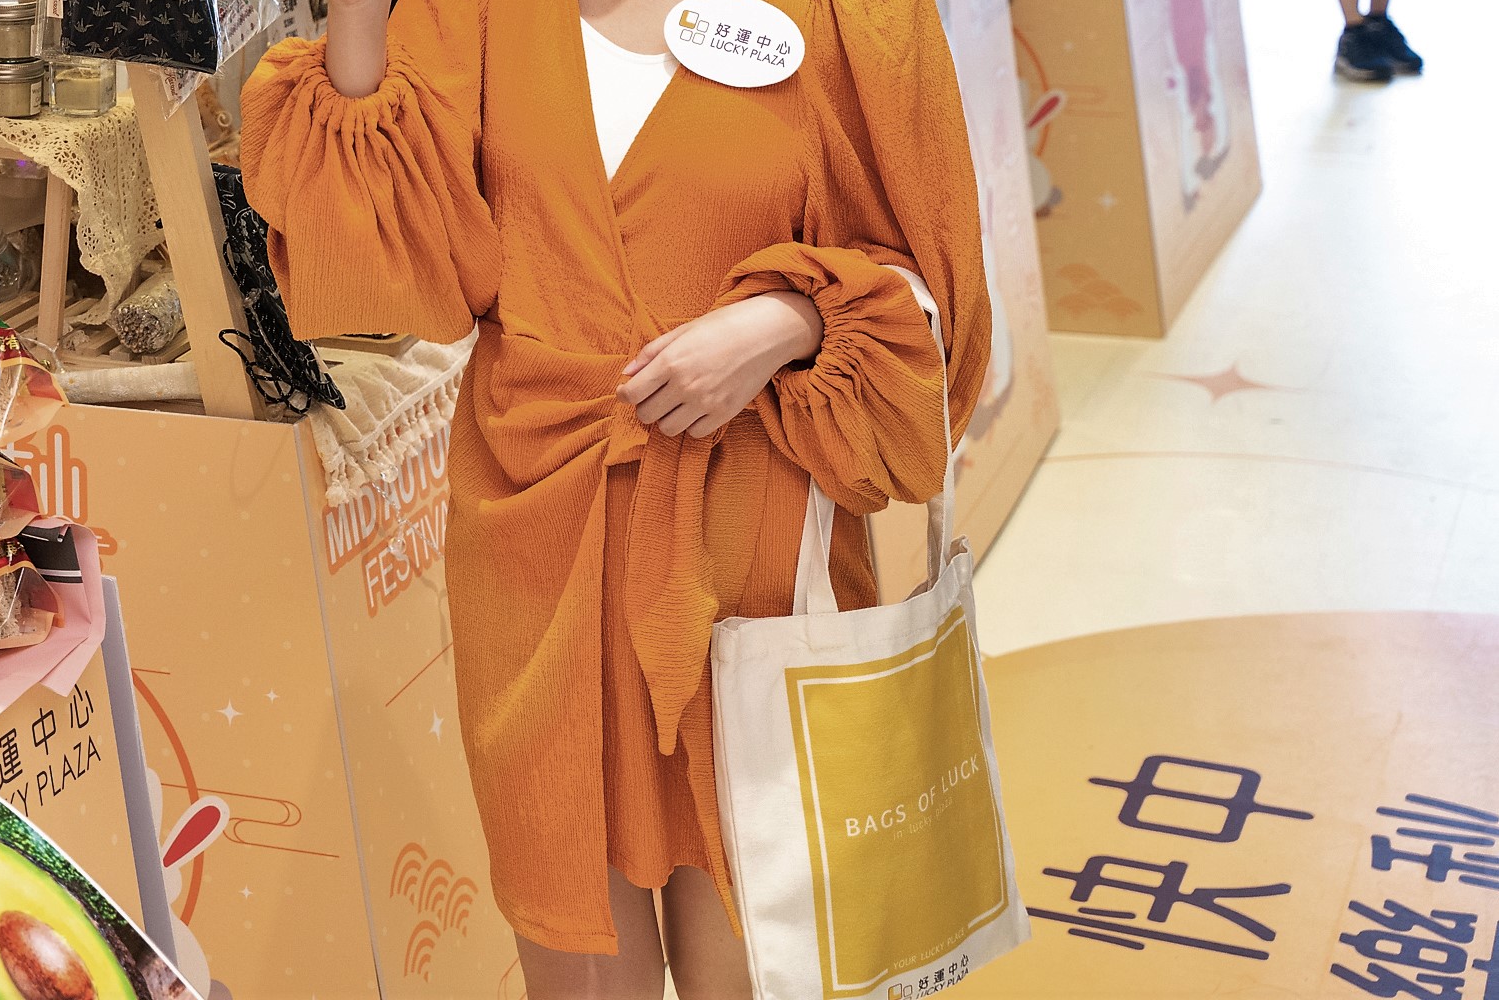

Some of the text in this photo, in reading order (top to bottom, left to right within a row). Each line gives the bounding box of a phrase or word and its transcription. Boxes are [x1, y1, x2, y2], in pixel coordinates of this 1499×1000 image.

[710, 37, 786, 68] LUCKY PLAZA
[714, 22, 791, 55] 好運中心
[326, 424, 451, 565] MID AUTU
[36, 735, 102, 807] PLAZA
[845, 753, 980, 838] BAGS OF LUCK
[908, 816, 933, 835] lucky
[893, 955, 917, 970] YOUR
[921, 941, 945, 960] LUCKY
[917, 953, 970, 991] 好運中心
